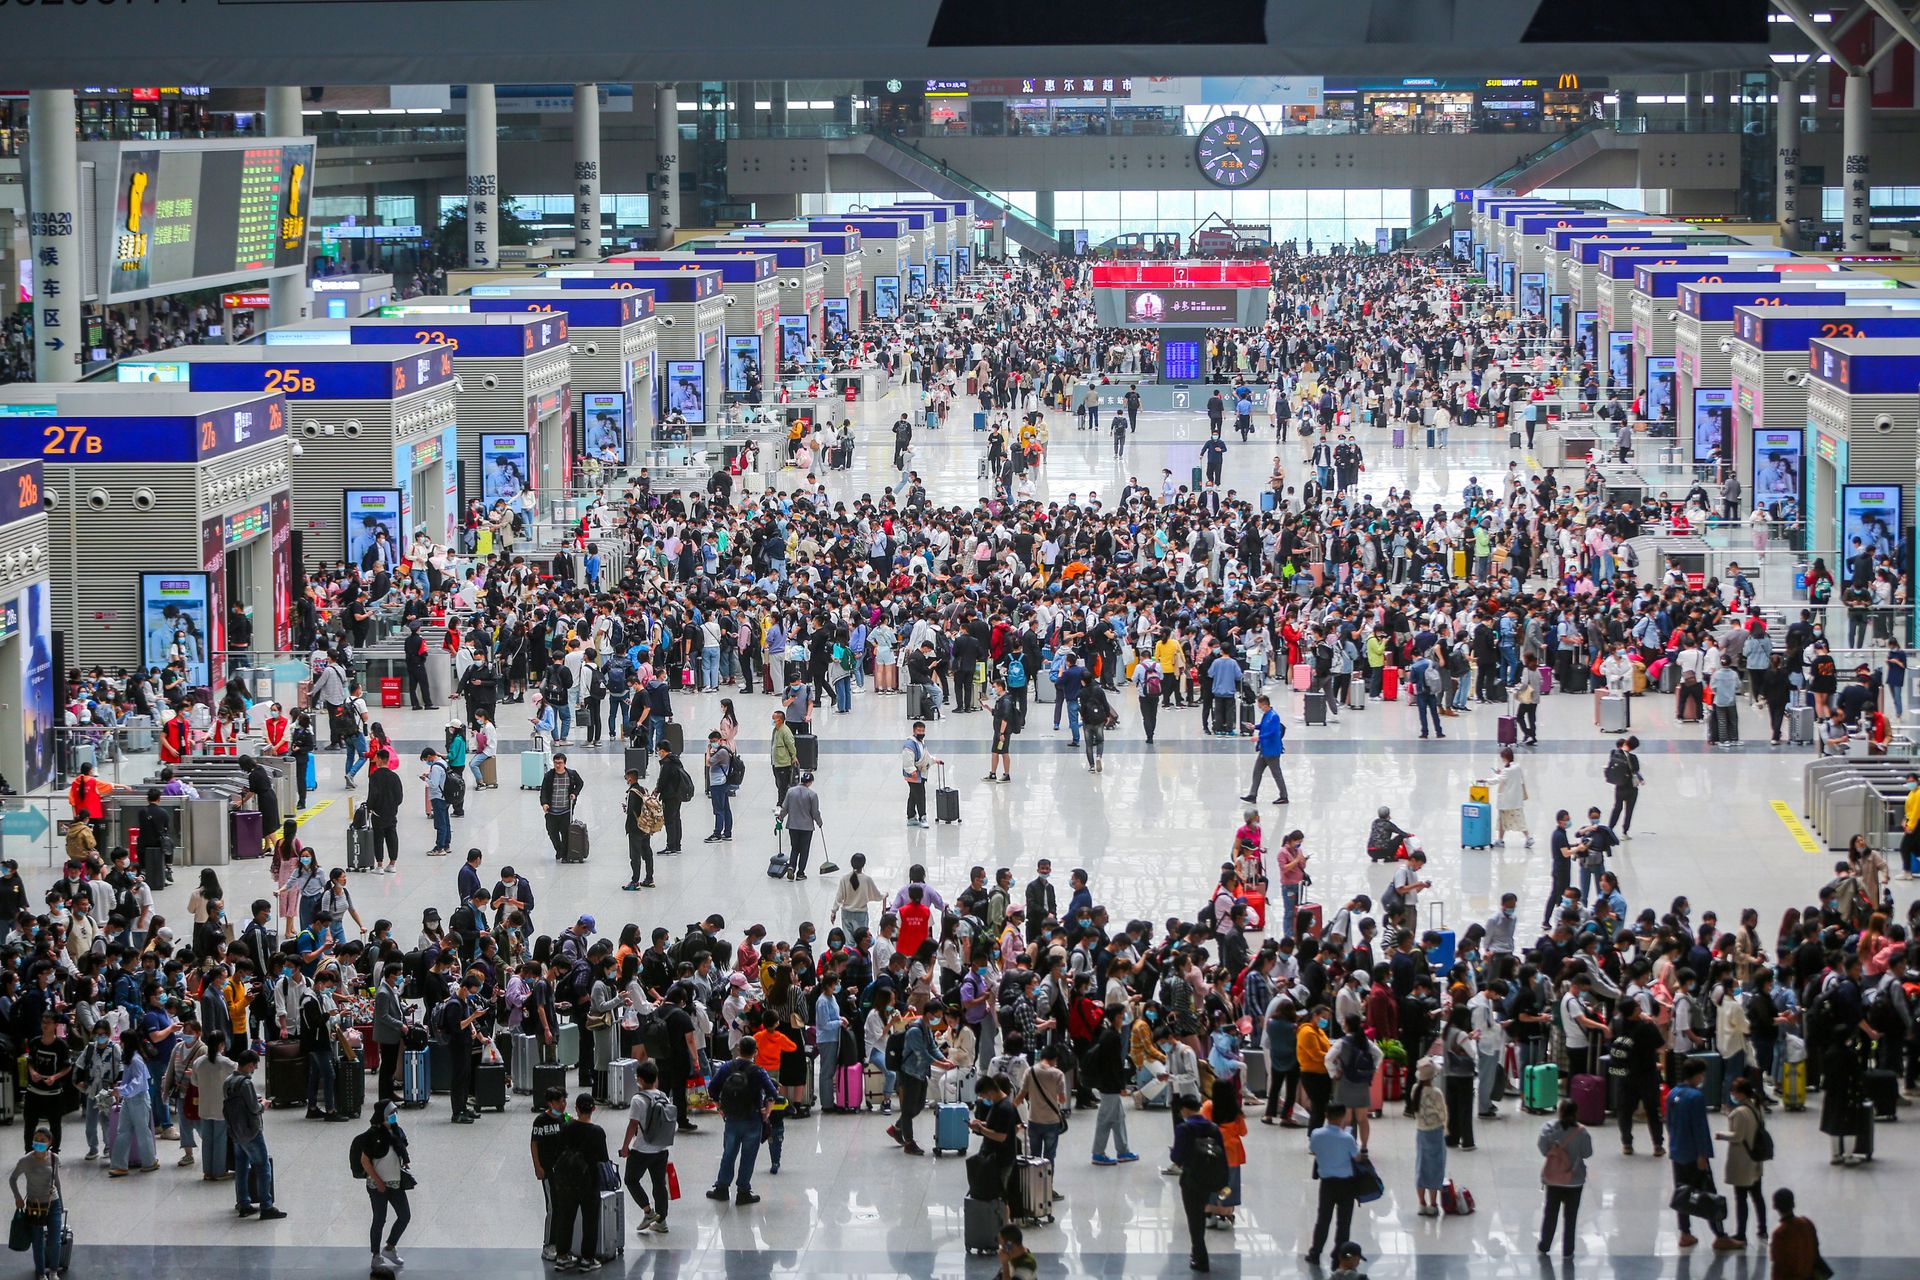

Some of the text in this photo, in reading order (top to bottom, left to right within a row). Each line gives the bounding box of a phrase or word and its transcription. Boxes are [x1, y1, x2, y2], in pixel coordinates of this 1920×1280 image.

[1044, 79, 1132, 92] 惠尔嘉超市
[580, 185, 591, 230] 候车区
[1459, 192, 1470, 200] 1A
[474, 201, 487, 253] 候车区
[39, 246, 61, 327] 候车区
[265, 369, 316, 392] 25B
[268, 403, 282, 431] 26B
[43, 426, 103, 454] 27B
[202, 421, 216, 451] 27B
[18, 474, 38, 509] 28B
[533, 1124, 560, 1136] DREAM
